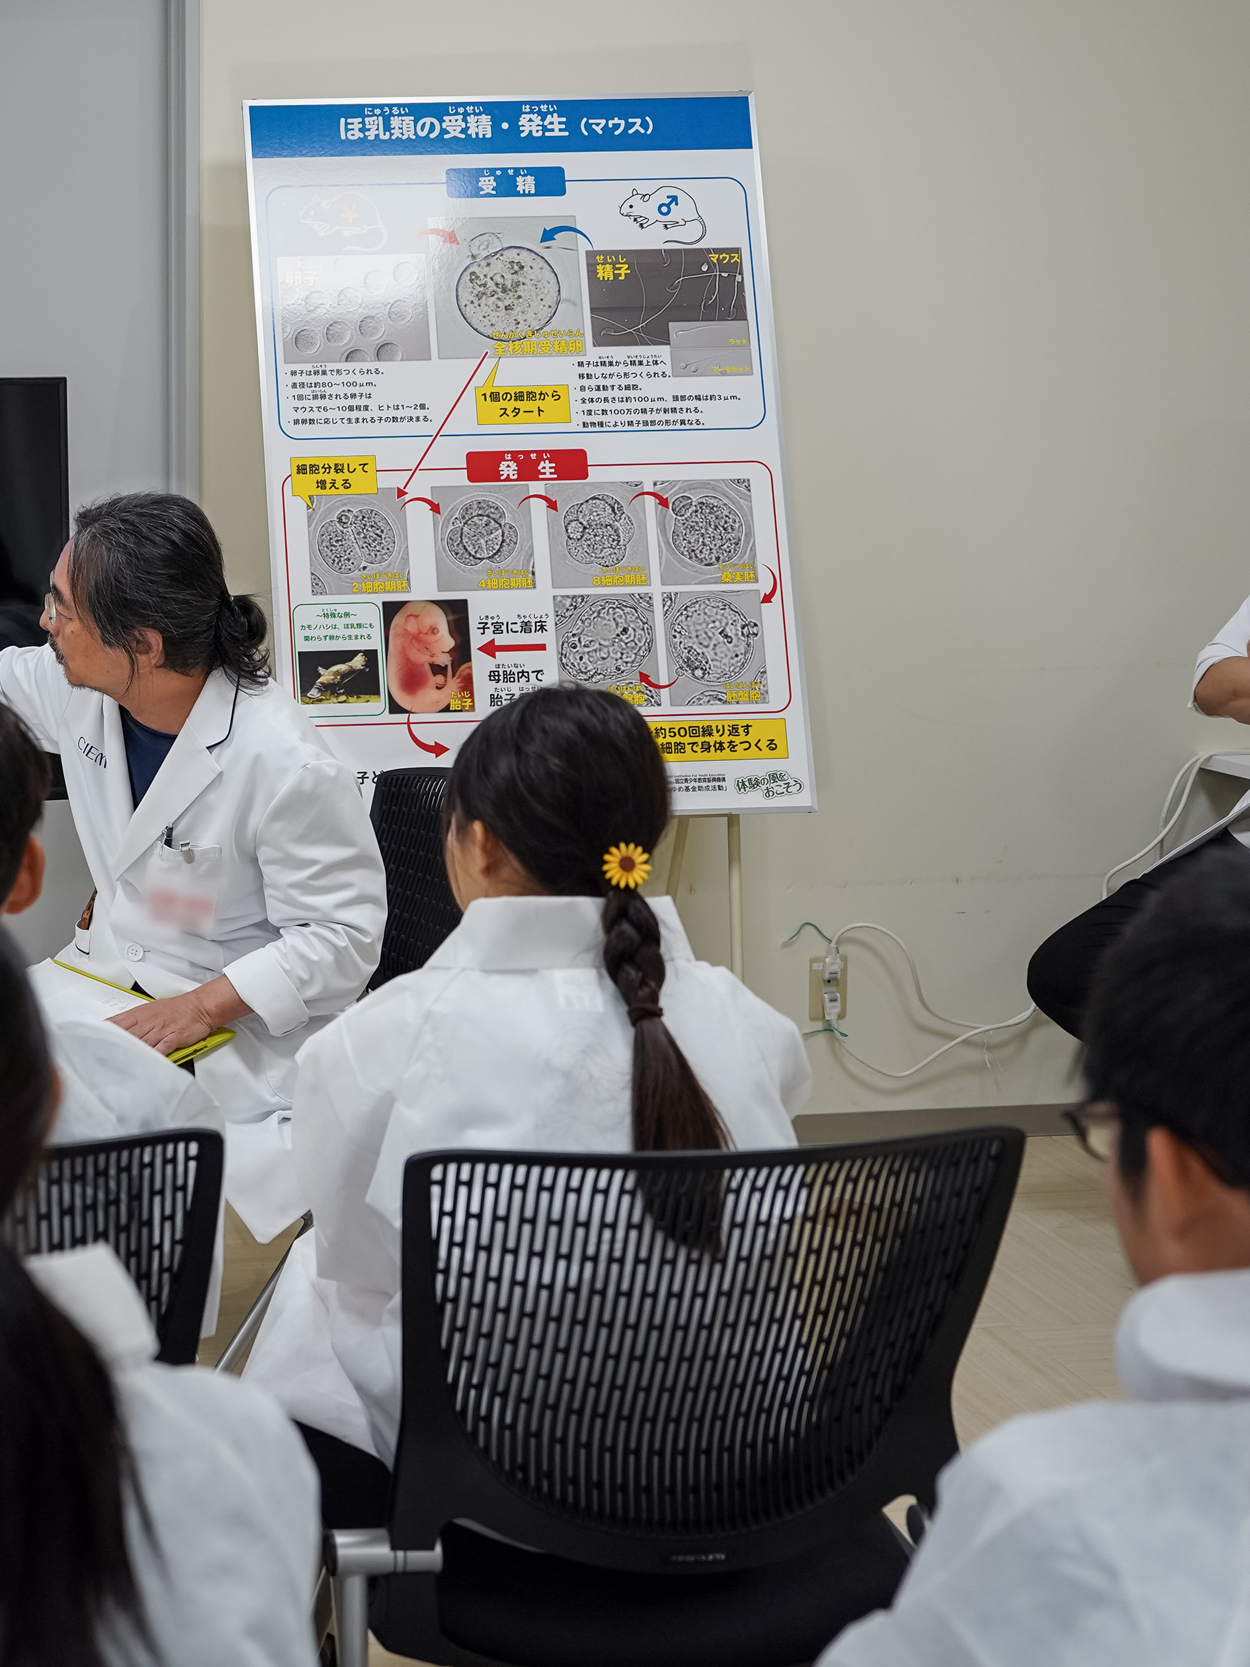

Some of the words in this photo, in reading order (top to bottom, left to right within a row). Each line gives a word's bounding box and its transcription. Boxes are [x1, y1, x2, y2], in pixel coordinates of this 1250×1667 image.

[364, 106, 409, 116] にゅうるい
[448, 105, 483, 114] じゅせい
[522, 104, 557, 112] はっせい
[596, 254, 626, 263] せいし
[708, 253, 740, 264] マウス
[596, 264, 630, 280] 精子
[492, 340, 583, 356] 全核期受精卵
[481, 390, 562, 402] 1個の細胞から
[499, 406, 545, 418] スタート
[504, 452, 550, 460] はっせい
[296, 462, 369, 475] 細胞分裂して
[316, 478, 352, 490] 増える
[592, 574, 648, 586] 8細胞期胚
[721, 571, 756, 583] 桑実胚
[352, 580, 409, 593] 2細胞期胚
[478, 577, 534, 590] 4細胞期胚
[476, 620, 548, 635] 子宮に着床
[488, 669, 544, 683] 母胎内で
[617, 693, 646, 705] 盤胞
[727, 690, 761, 702] 胚盤胞
[450, 698, 473, 711] 胎子
[648, 724, 752, 740] 約50回繰り返す
[77, 736, 107, 769] CIEM
[660, 738, 778, 755] 細胞で身体をつくる
[764, 778, 803, 798] おこそう
